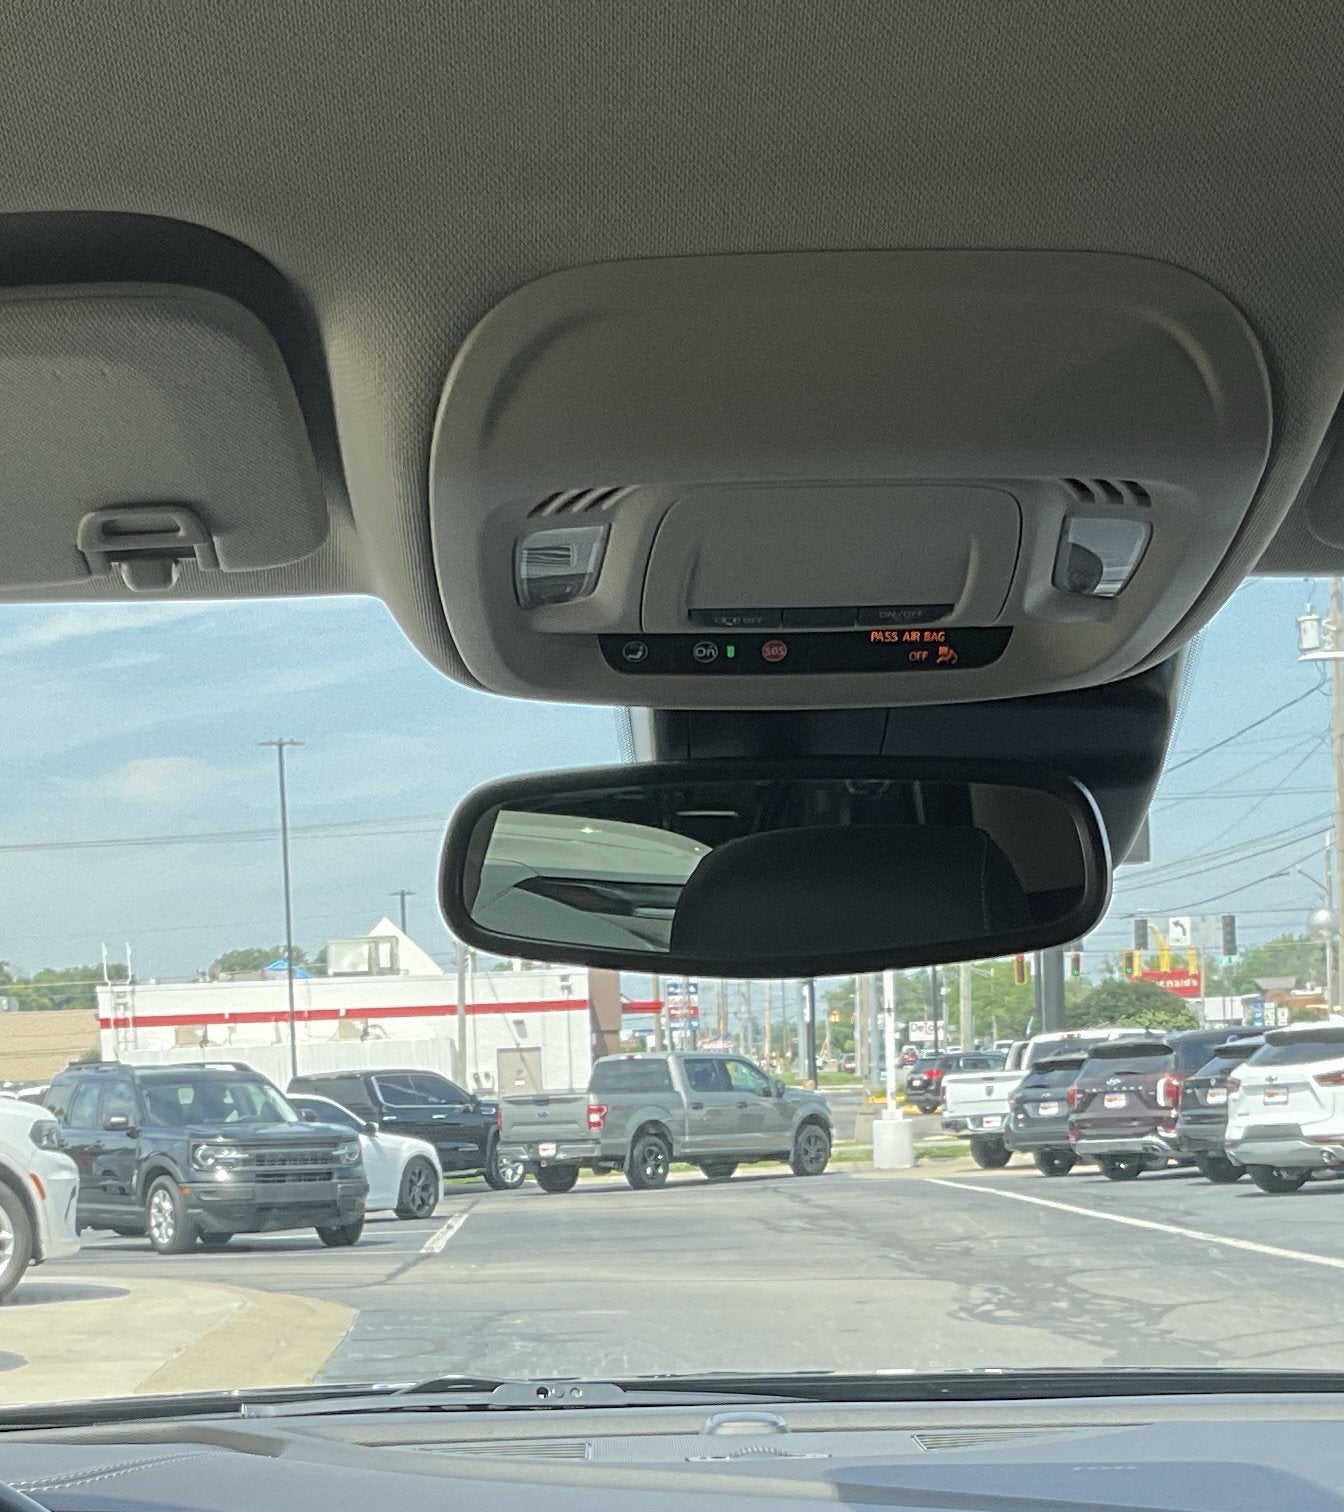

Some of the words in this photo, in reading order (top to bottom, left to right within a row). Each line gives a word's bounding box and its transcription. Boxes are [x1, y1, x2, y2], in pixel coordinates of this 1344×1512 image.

[870, 631, 897, 642] PASS
[902, 631, 921, 641] AIR
[923, 631, 946, 642] BAG
[764, 645, 785, 656] SOS
[908, 651, 929, 662] OFF
